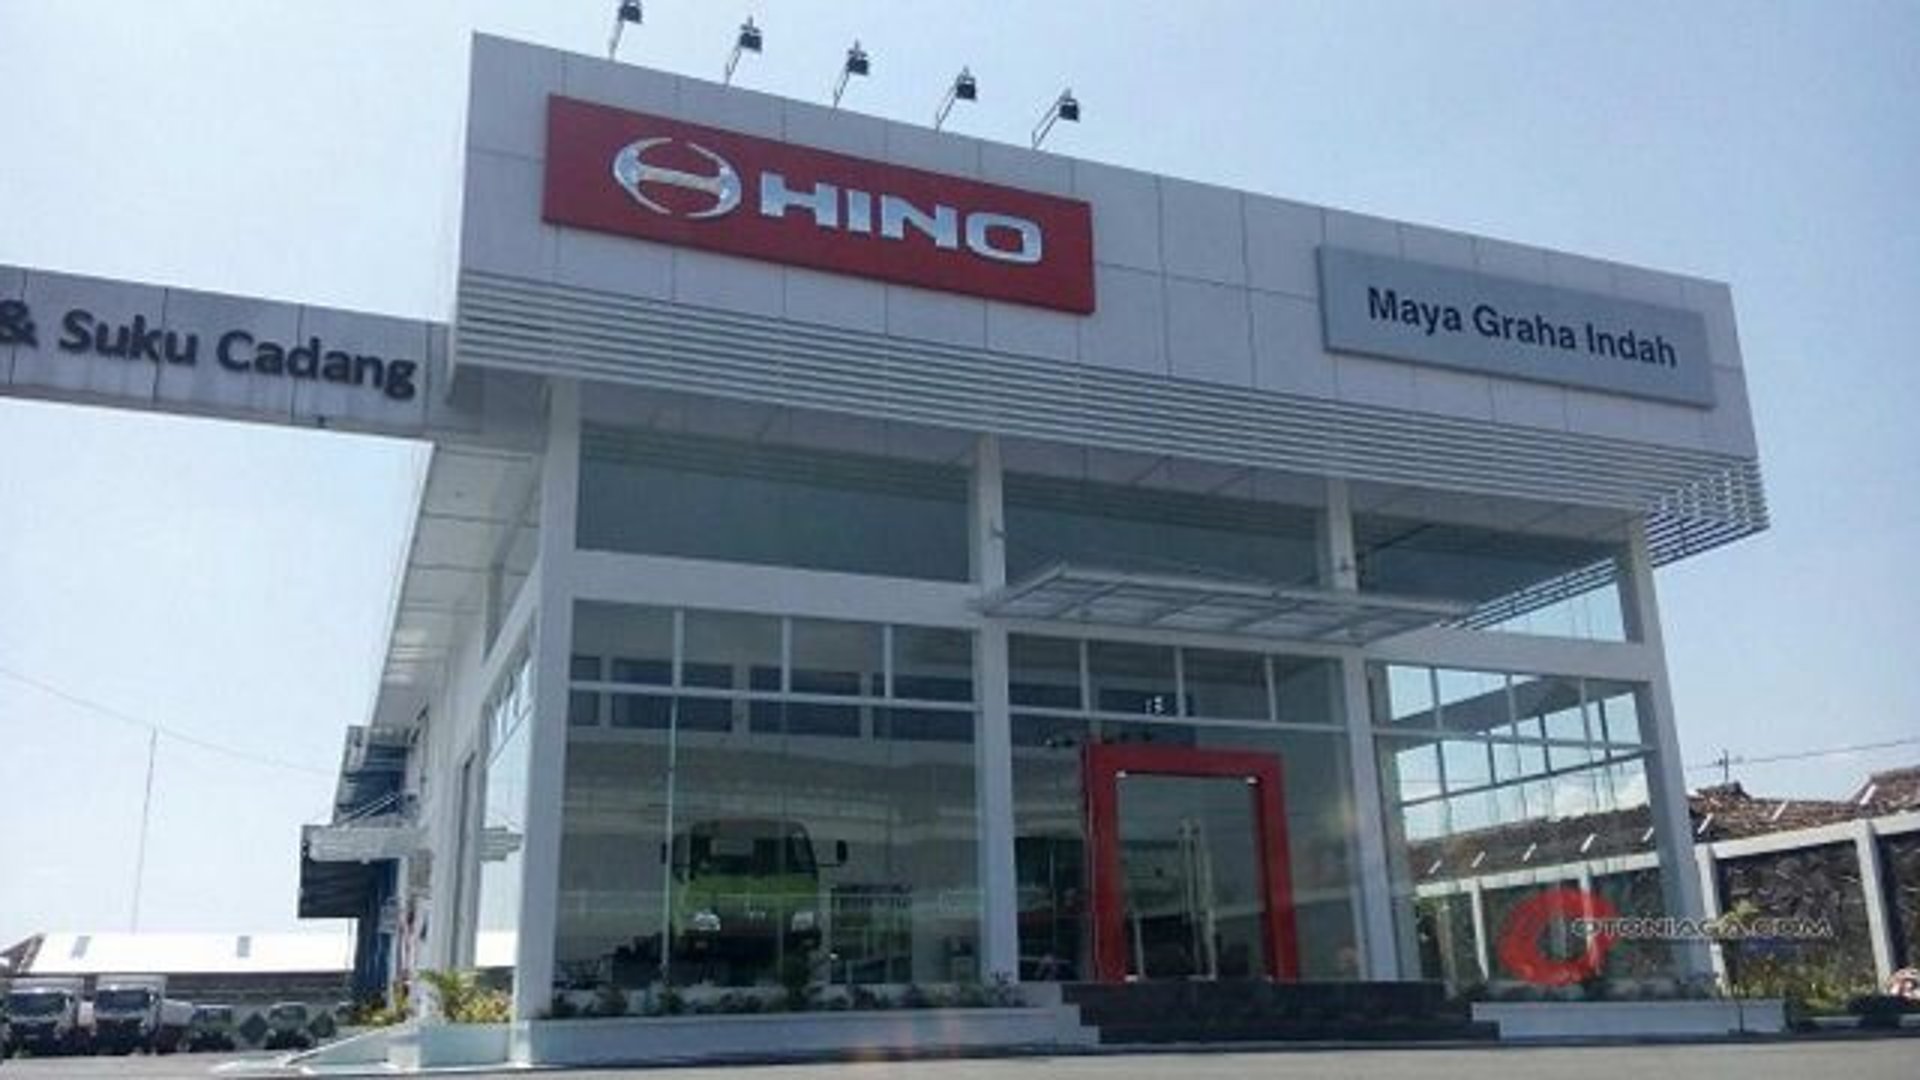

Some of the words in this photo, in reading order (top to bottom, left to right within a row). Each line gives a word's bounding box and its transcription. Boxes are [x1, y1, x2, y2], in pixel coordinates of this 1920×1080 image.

[760, 172, 1042, 264] HINO
[0, 300, 38, 349] &
[59, 309, 198, 366] Suku
[216, 330, 417, 401] Cadang
[1368, 286, 1462, 336] Maya
[1473, 304, 1577, 351] Graha
[1587, 322, 1678, 368] Indah
